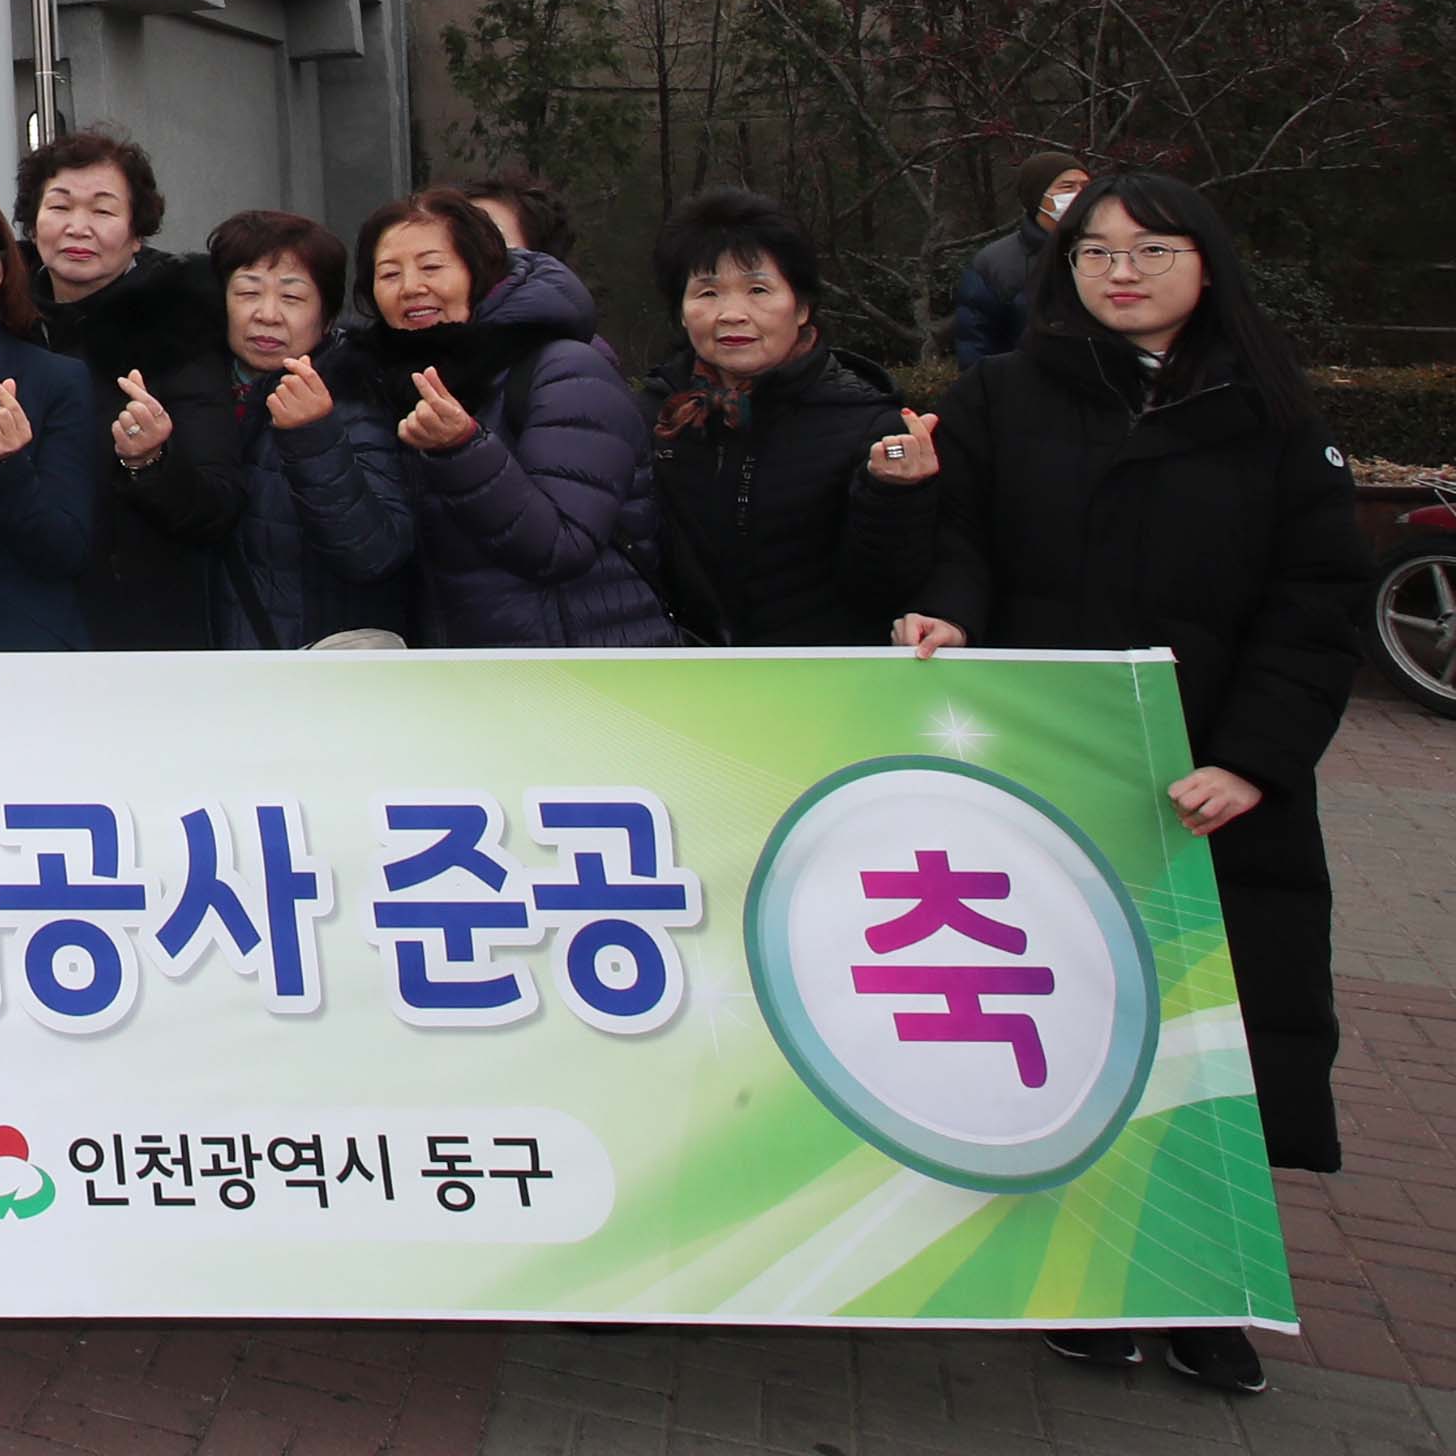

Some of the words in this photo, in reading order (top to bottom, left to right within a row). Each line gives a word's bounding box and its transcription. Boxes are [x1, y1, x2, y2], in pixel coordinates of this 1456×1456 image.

[374, 802, 688, 1017] 준공
[851, 850, 1055, 1089] 축
[68, 1134, 396, 1211] 인천광역시
[421, 1135, 554, 1213] 동구
